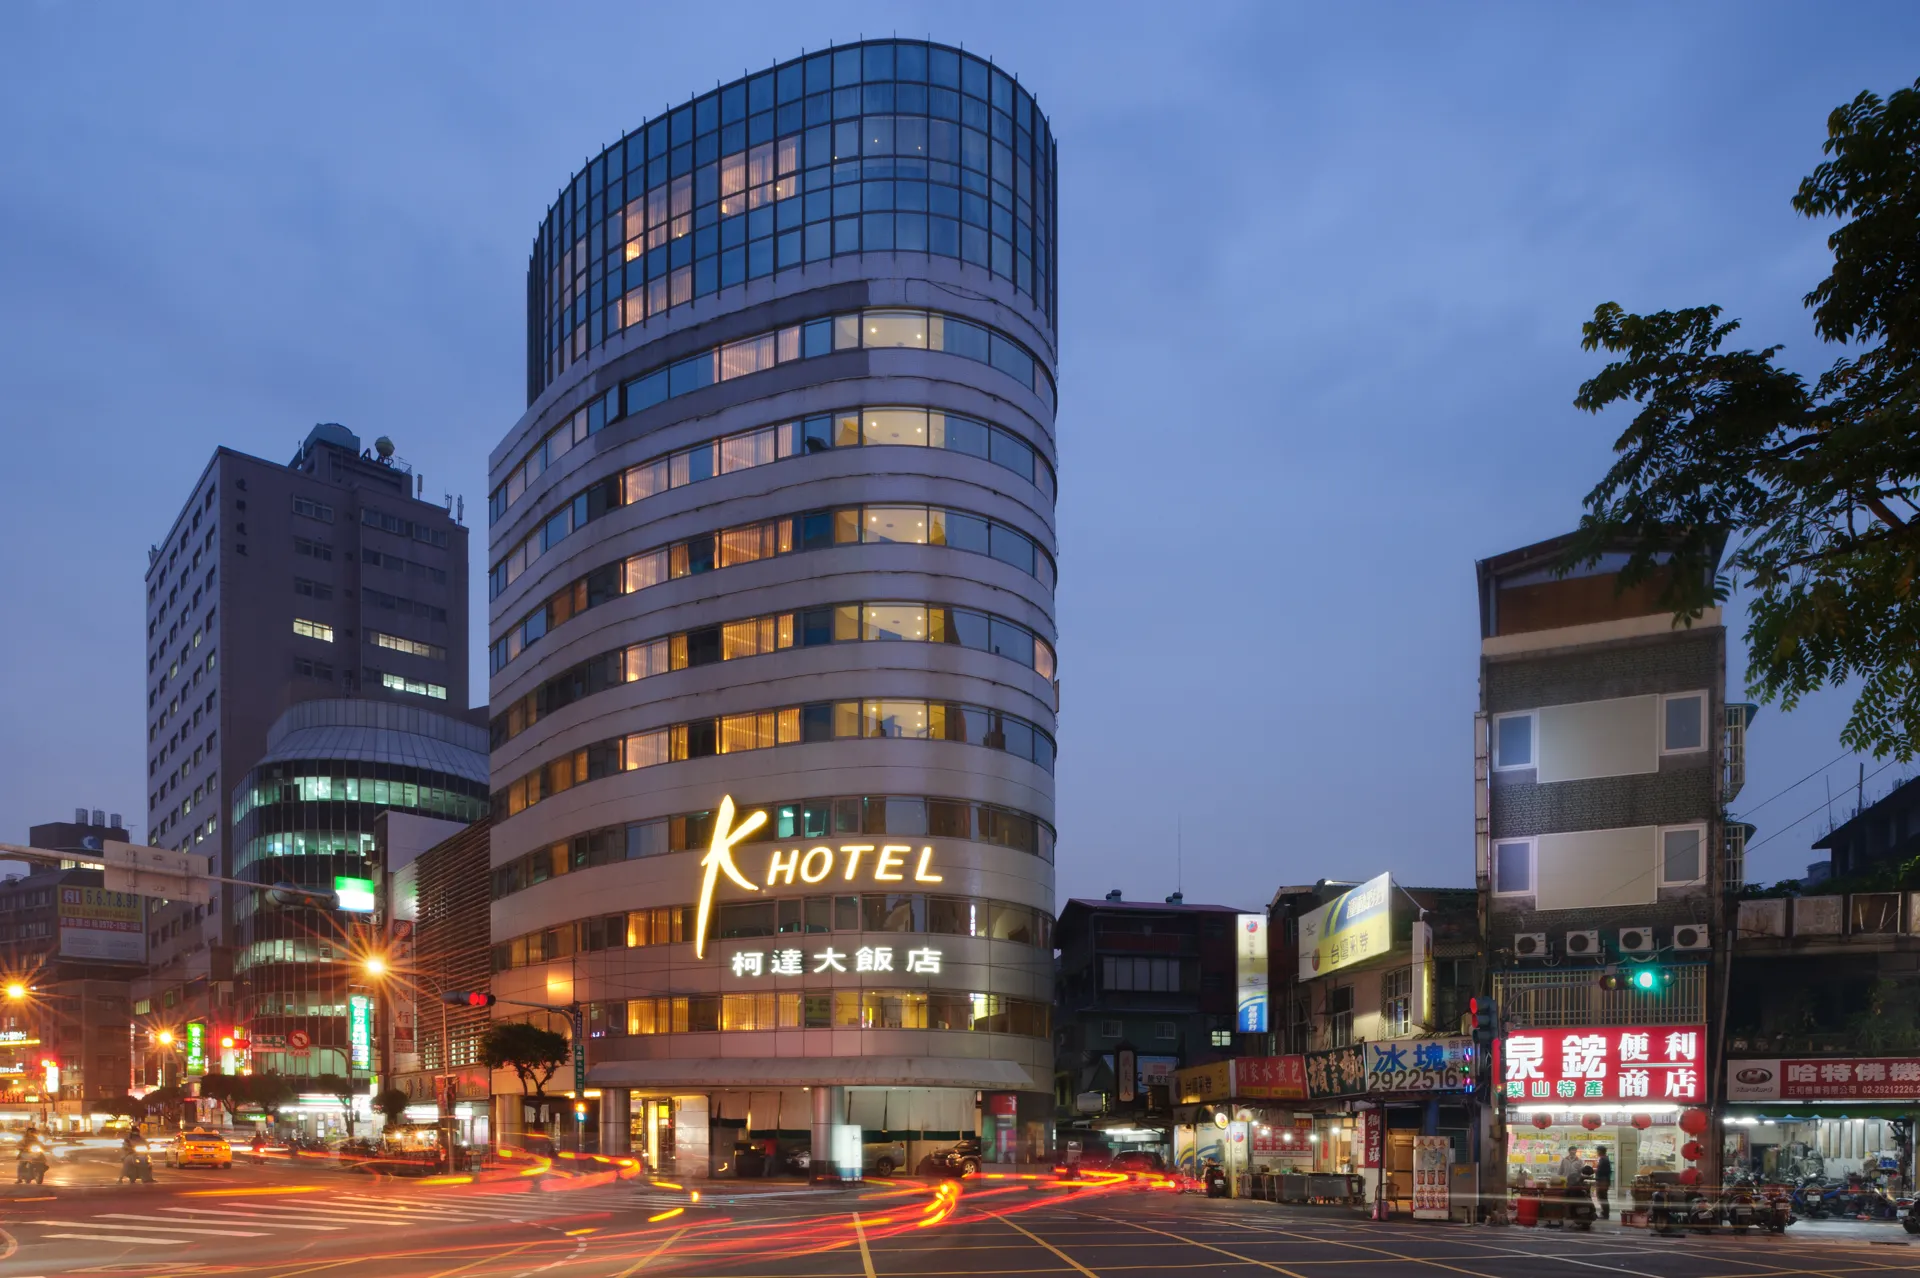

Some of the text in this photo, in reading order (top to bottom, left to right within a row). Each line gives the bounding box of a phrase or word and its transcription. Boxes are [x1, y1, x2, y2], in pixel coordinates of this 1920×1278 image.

[696, 794, 943, 960] K HOTEL
[731, 946, 943, 977] 柯達大飯店
[1373, 1042, 1448, 1073] 冰塊
[1618, 1031, 1698, 1061] 便利
[1368, 1067, 1476, 1092] 2922516
[1507, 1080, 1604, 1098] 梨山特產
[1618, 1068, 1698, 1098] 商店
